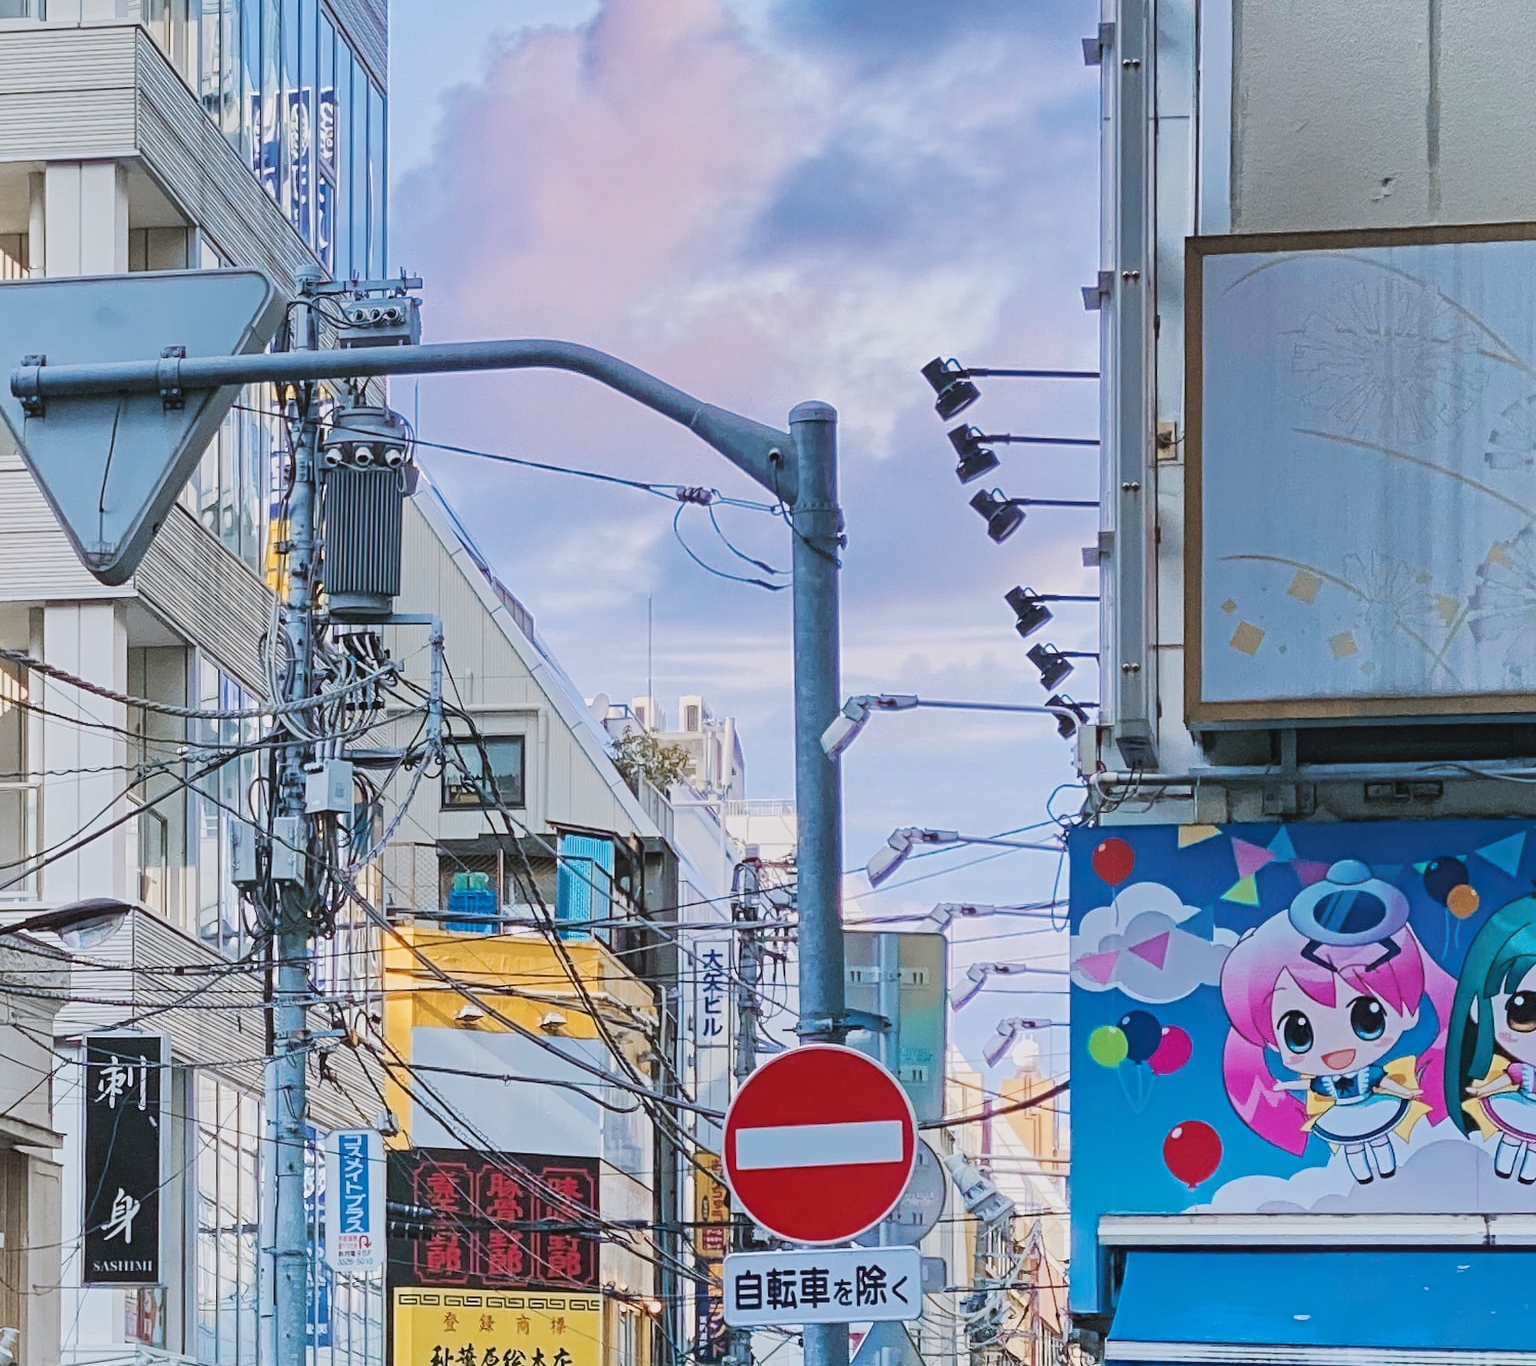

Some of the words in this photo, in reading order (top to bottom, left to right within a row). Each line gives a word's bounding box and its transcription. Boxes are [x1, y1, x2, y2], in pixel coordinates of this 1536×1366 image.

[701, 947, 724, 1037] 大矢ビル
[343, 1134, 367, 1233] コスメイトプラス
[92, 1258, 155, 1275] SASHIMI
[734, 1265, 911, 1312] 自転車を除く
[442, 1311, 567, 1336] 登録商標
